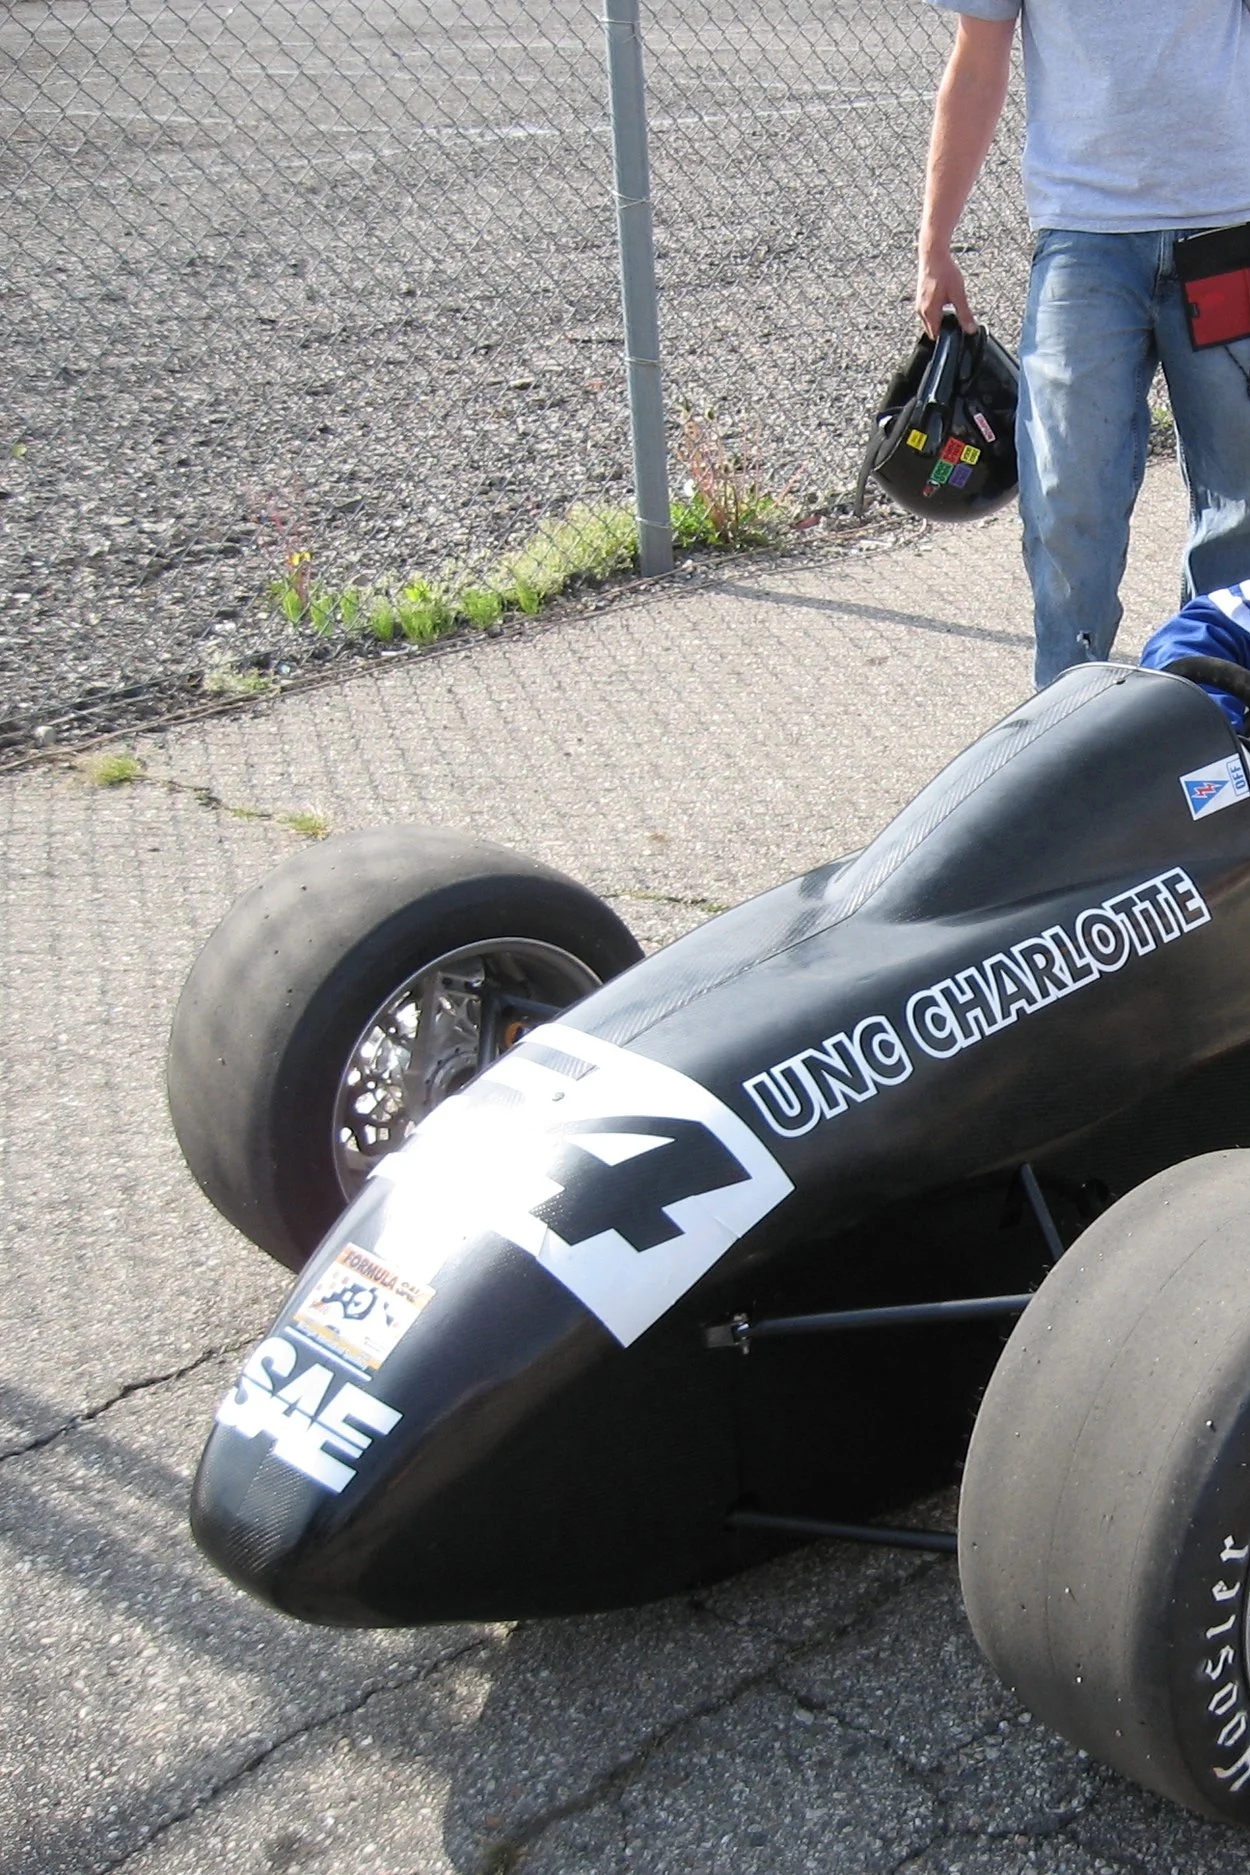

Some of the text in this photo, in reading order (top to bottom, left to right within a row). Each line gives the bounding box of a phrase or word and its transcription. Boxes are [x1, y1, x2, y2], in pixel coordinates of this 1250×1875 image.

[1229, 765, 1248, 790] OFF
[743, 866, 1212, 1139] UNC CHARLOTTE
[342, 1250, 399, 1291] FORMULA
[215, 1336, 404, 1494] SAE
